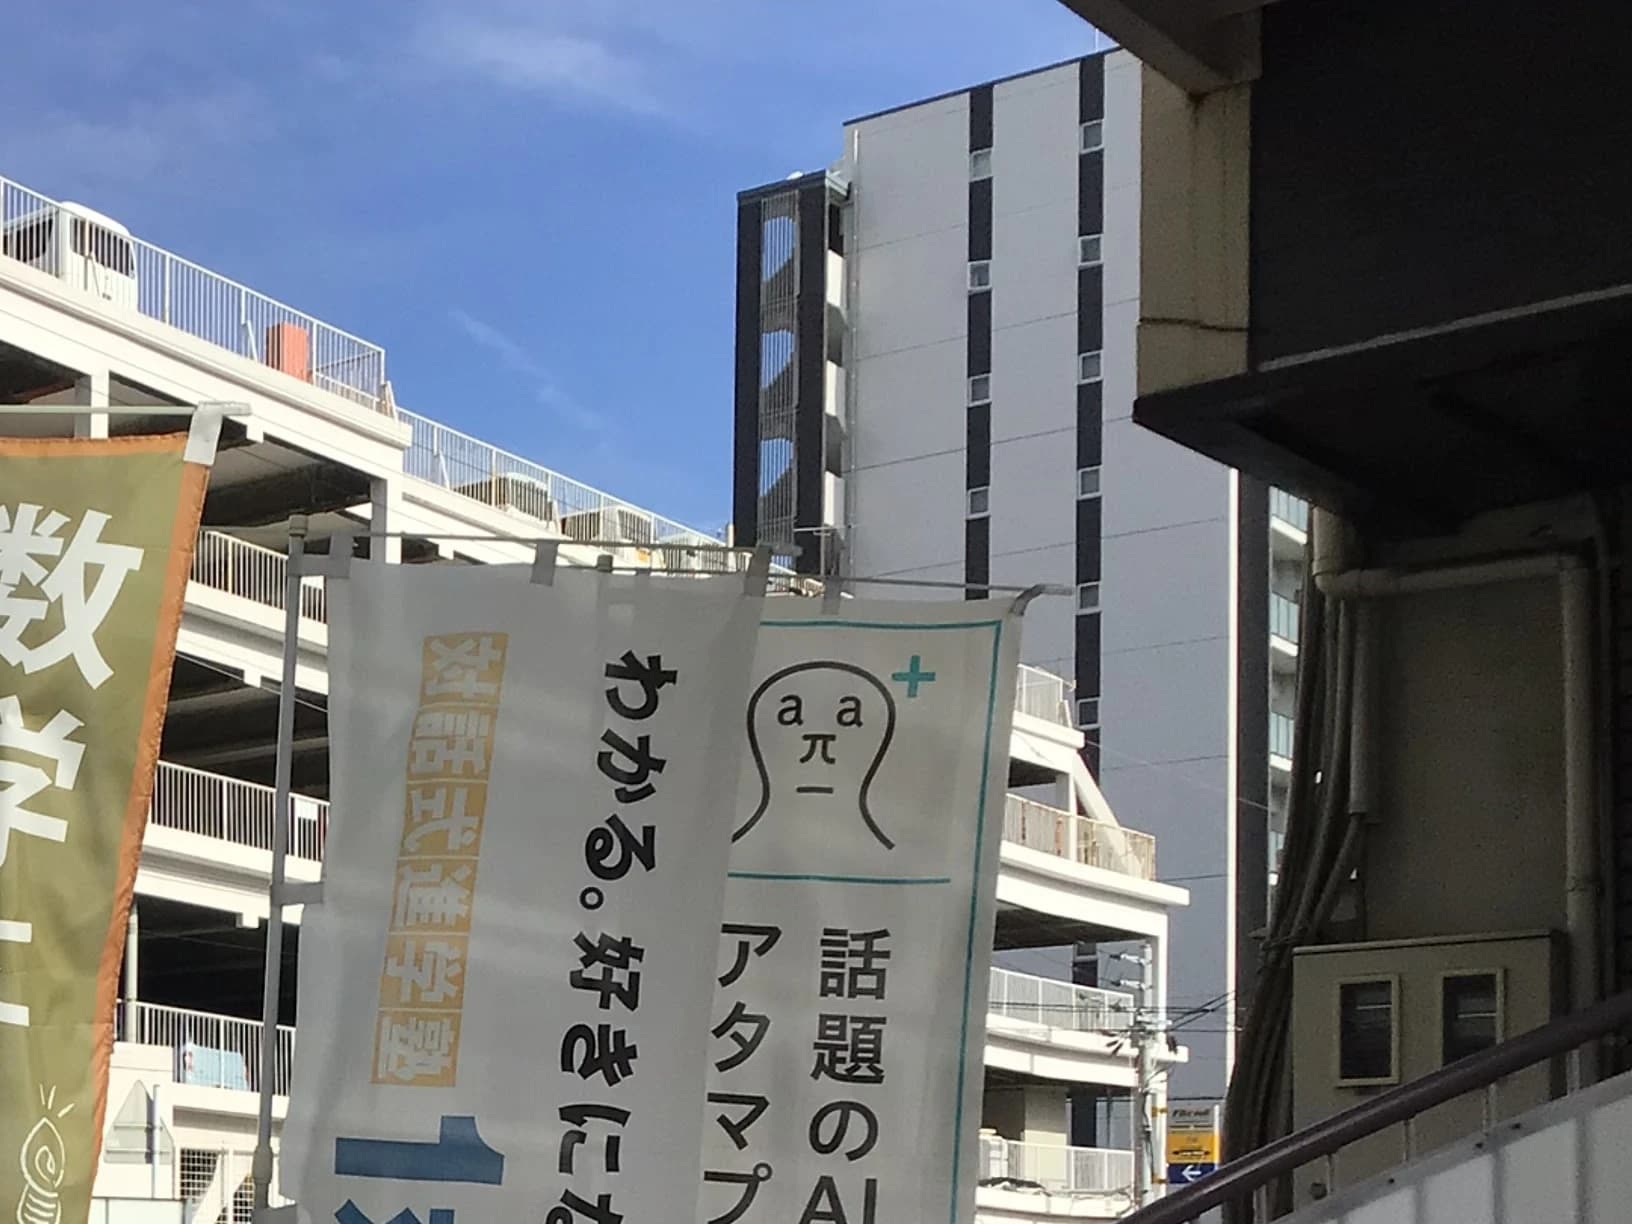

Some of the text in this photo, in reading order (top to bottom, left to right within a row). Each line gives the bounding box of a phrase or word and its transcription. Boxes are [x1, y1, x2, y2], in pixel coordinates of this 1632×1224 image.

[374, 634, 506, 1086] 対話式進学塾
